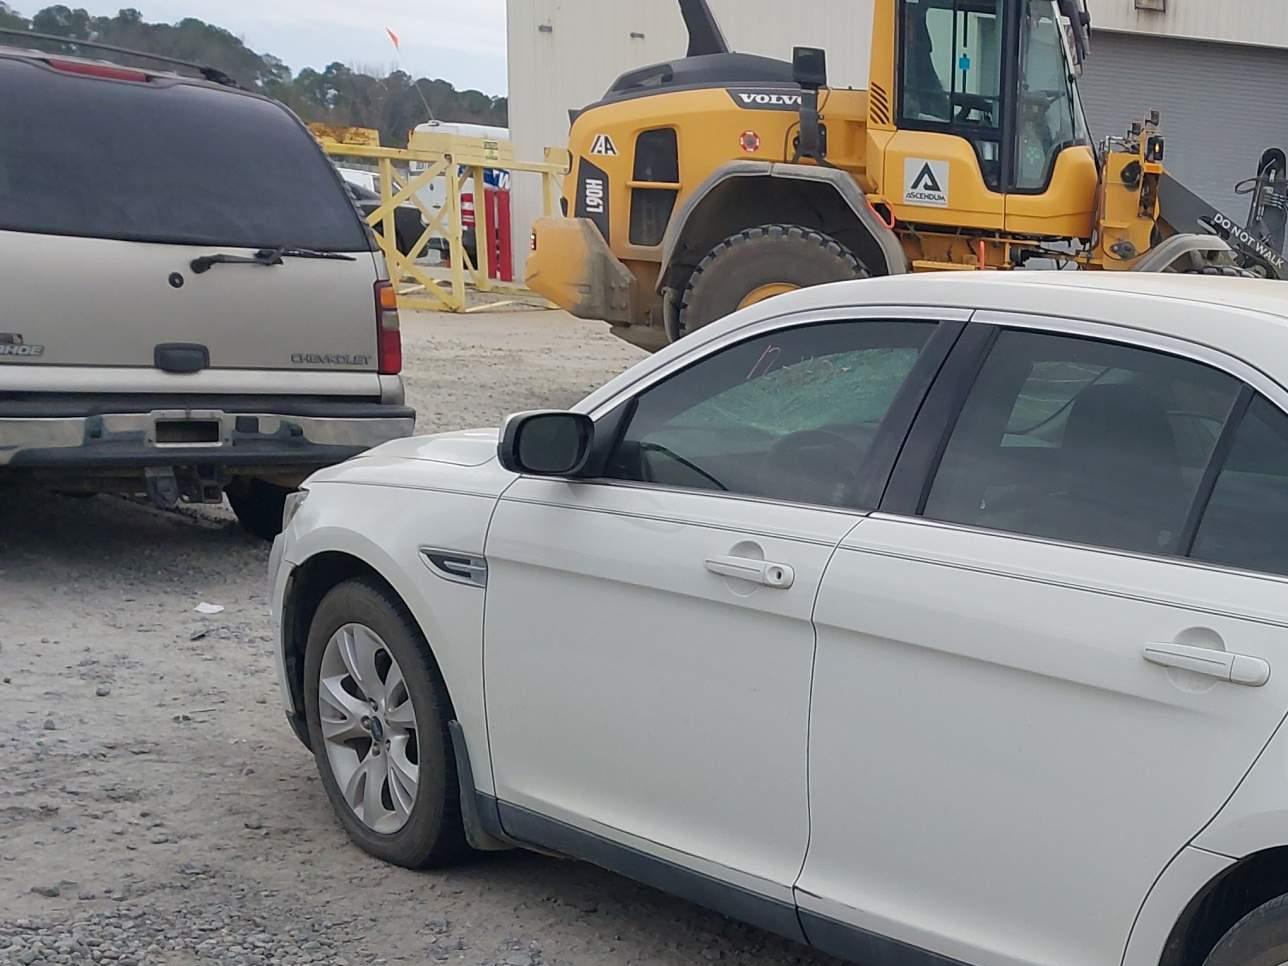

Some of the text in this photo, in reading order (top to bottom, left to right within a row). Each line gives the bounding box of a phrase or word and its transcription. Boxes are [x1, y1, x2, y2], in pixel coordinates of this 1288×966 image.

[585, 178, 603, 214] L90H
[905, 192, 946, 202] ASCENDUM
[1214, 213, 1285, 269] DO NOT WALK
[290, 353, 372, 366] CHEVROLET
